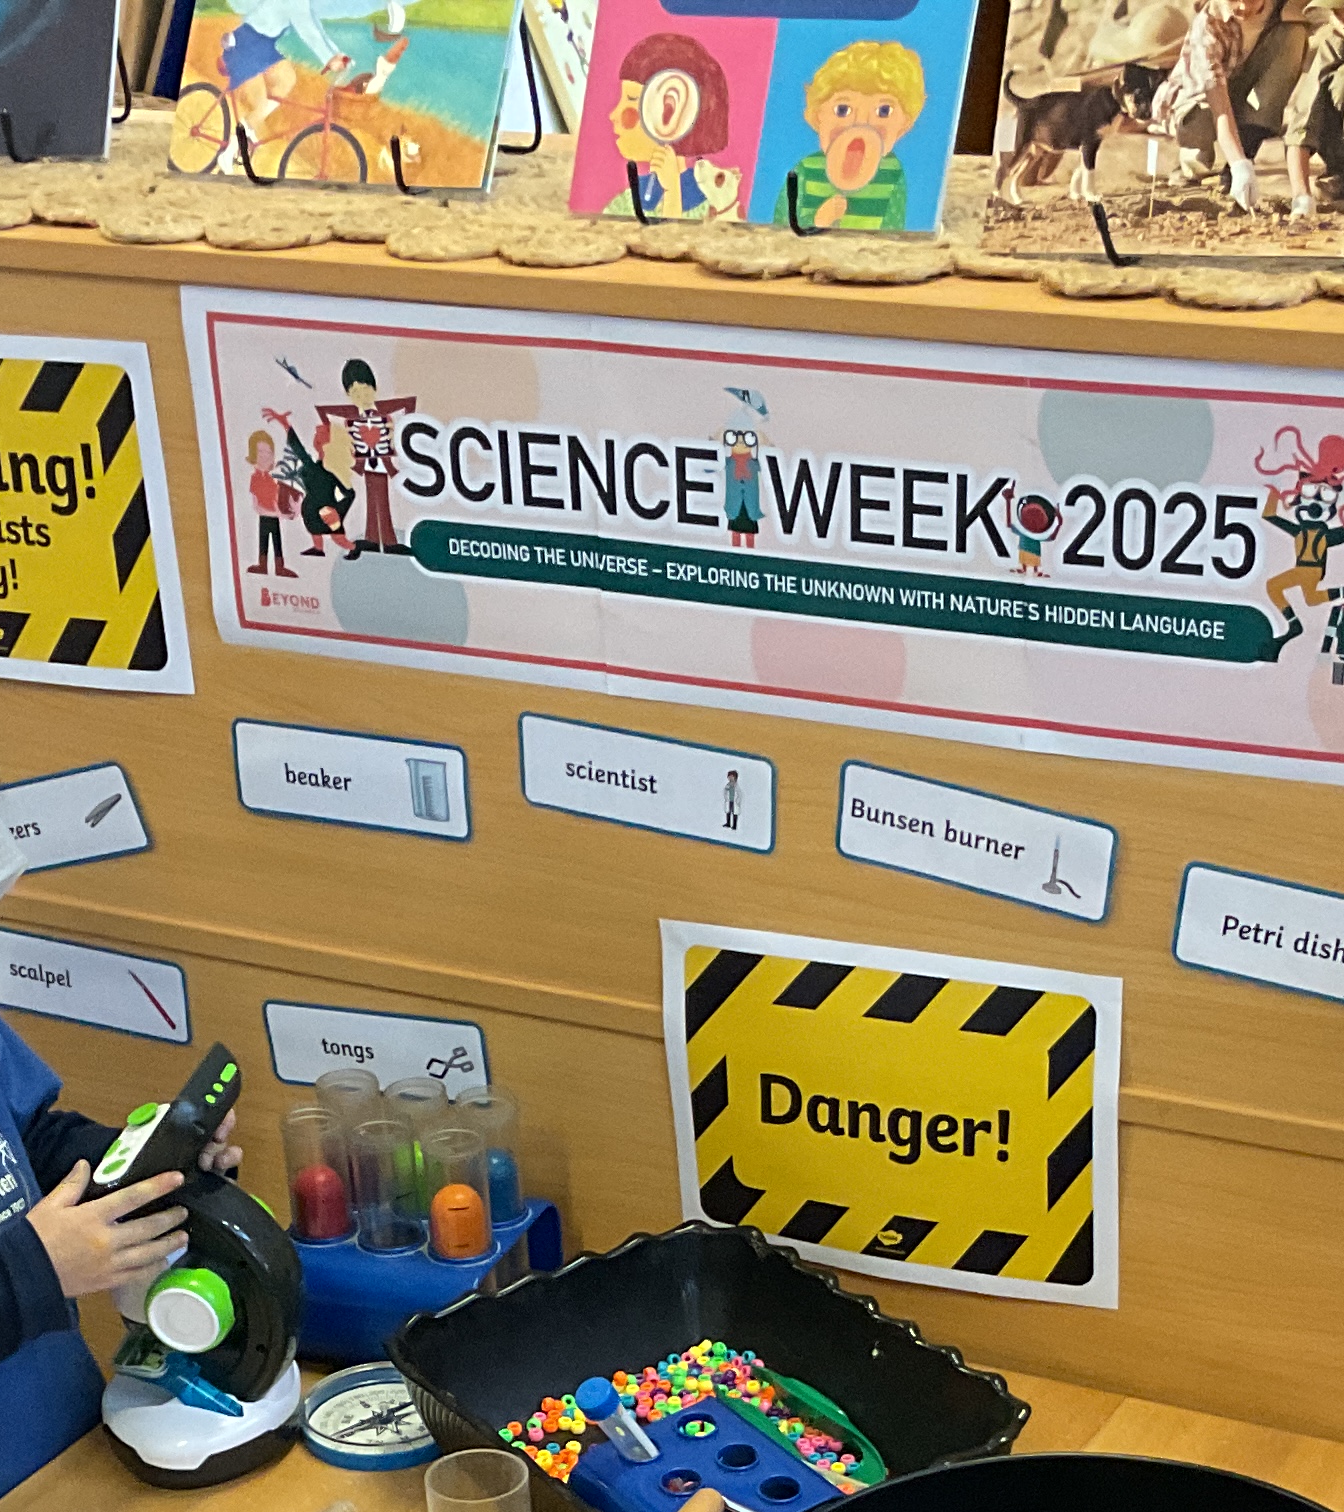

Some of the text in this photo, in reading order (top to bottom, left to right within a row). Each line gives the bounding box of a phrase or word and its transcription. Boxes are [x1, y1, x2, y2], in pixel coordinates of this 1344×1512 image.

[400, 420, 1258, 580] SCIENCE WEEK 2025
[260, 587, 320, 609] BEYOND
[448, 537, 532, 563] DECODING
[535, 544, 567, 566] THE
[569, 546, 649, 578] UNIVERSE
[665, 561, 761, 592] EXPLORING
[764, 571, 798, 595] THE
[801, 575, 896, 606] UNKNOWN
[900, 584, 946, 611] WITH
[950, 594, 1041, 621] NATURE'S
[1045, 603, 1115, 631] HIDDEN
[1120, 610, 1226, 642] LANGUAGE
[284, 763, 352, 793] beaker
[564, 760, 658, 795] scientist
[850, 798, 1026, 862] Bunsen burner
[1221, 915, 1284, 951] Petri
[8, 961, 72, 989] scalpel
[321, 1037, 376, 1063] tongs
[759, 1073, 1011, 1166] Danger!
